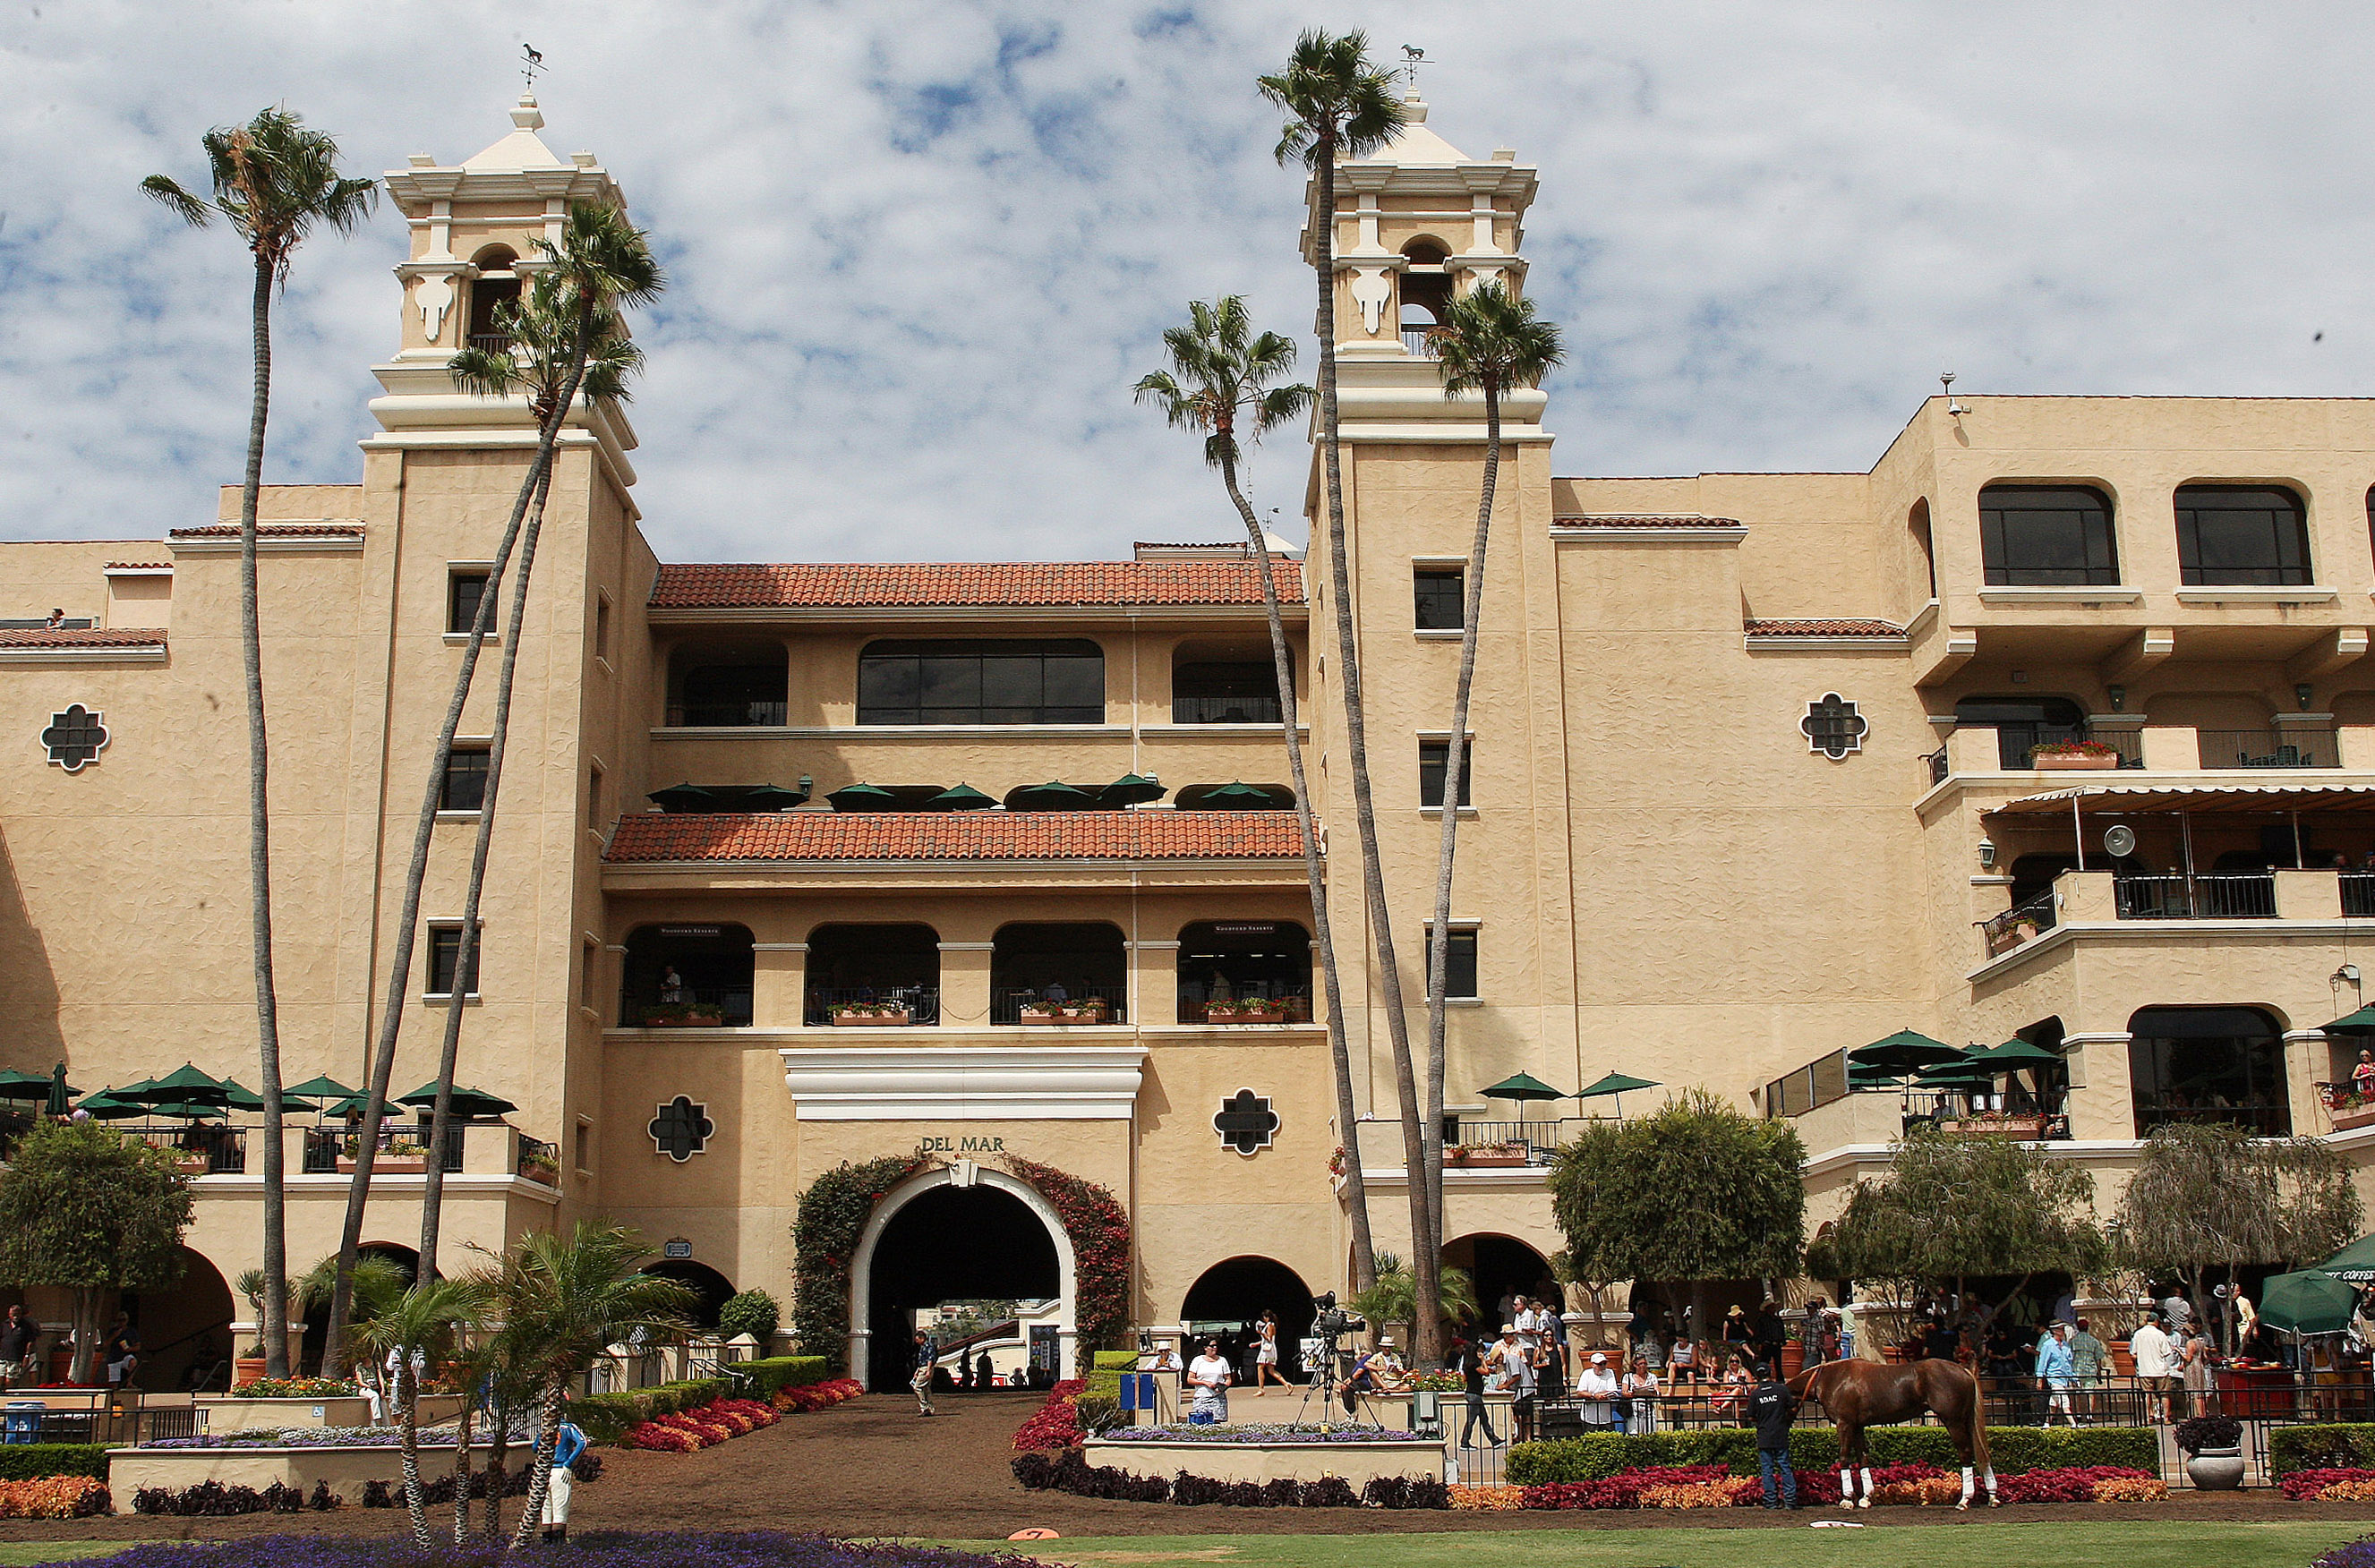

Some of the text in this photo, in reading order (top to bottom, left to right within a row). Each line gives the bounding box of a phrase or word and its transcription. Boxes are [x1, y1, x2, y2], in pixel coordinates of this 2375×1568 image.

[922, 1137, 1004, 1152] DEL MAR
[2342, 1270, 2375, 1280] COFFEE
[1026, 1530, 1044, 1539] 7
